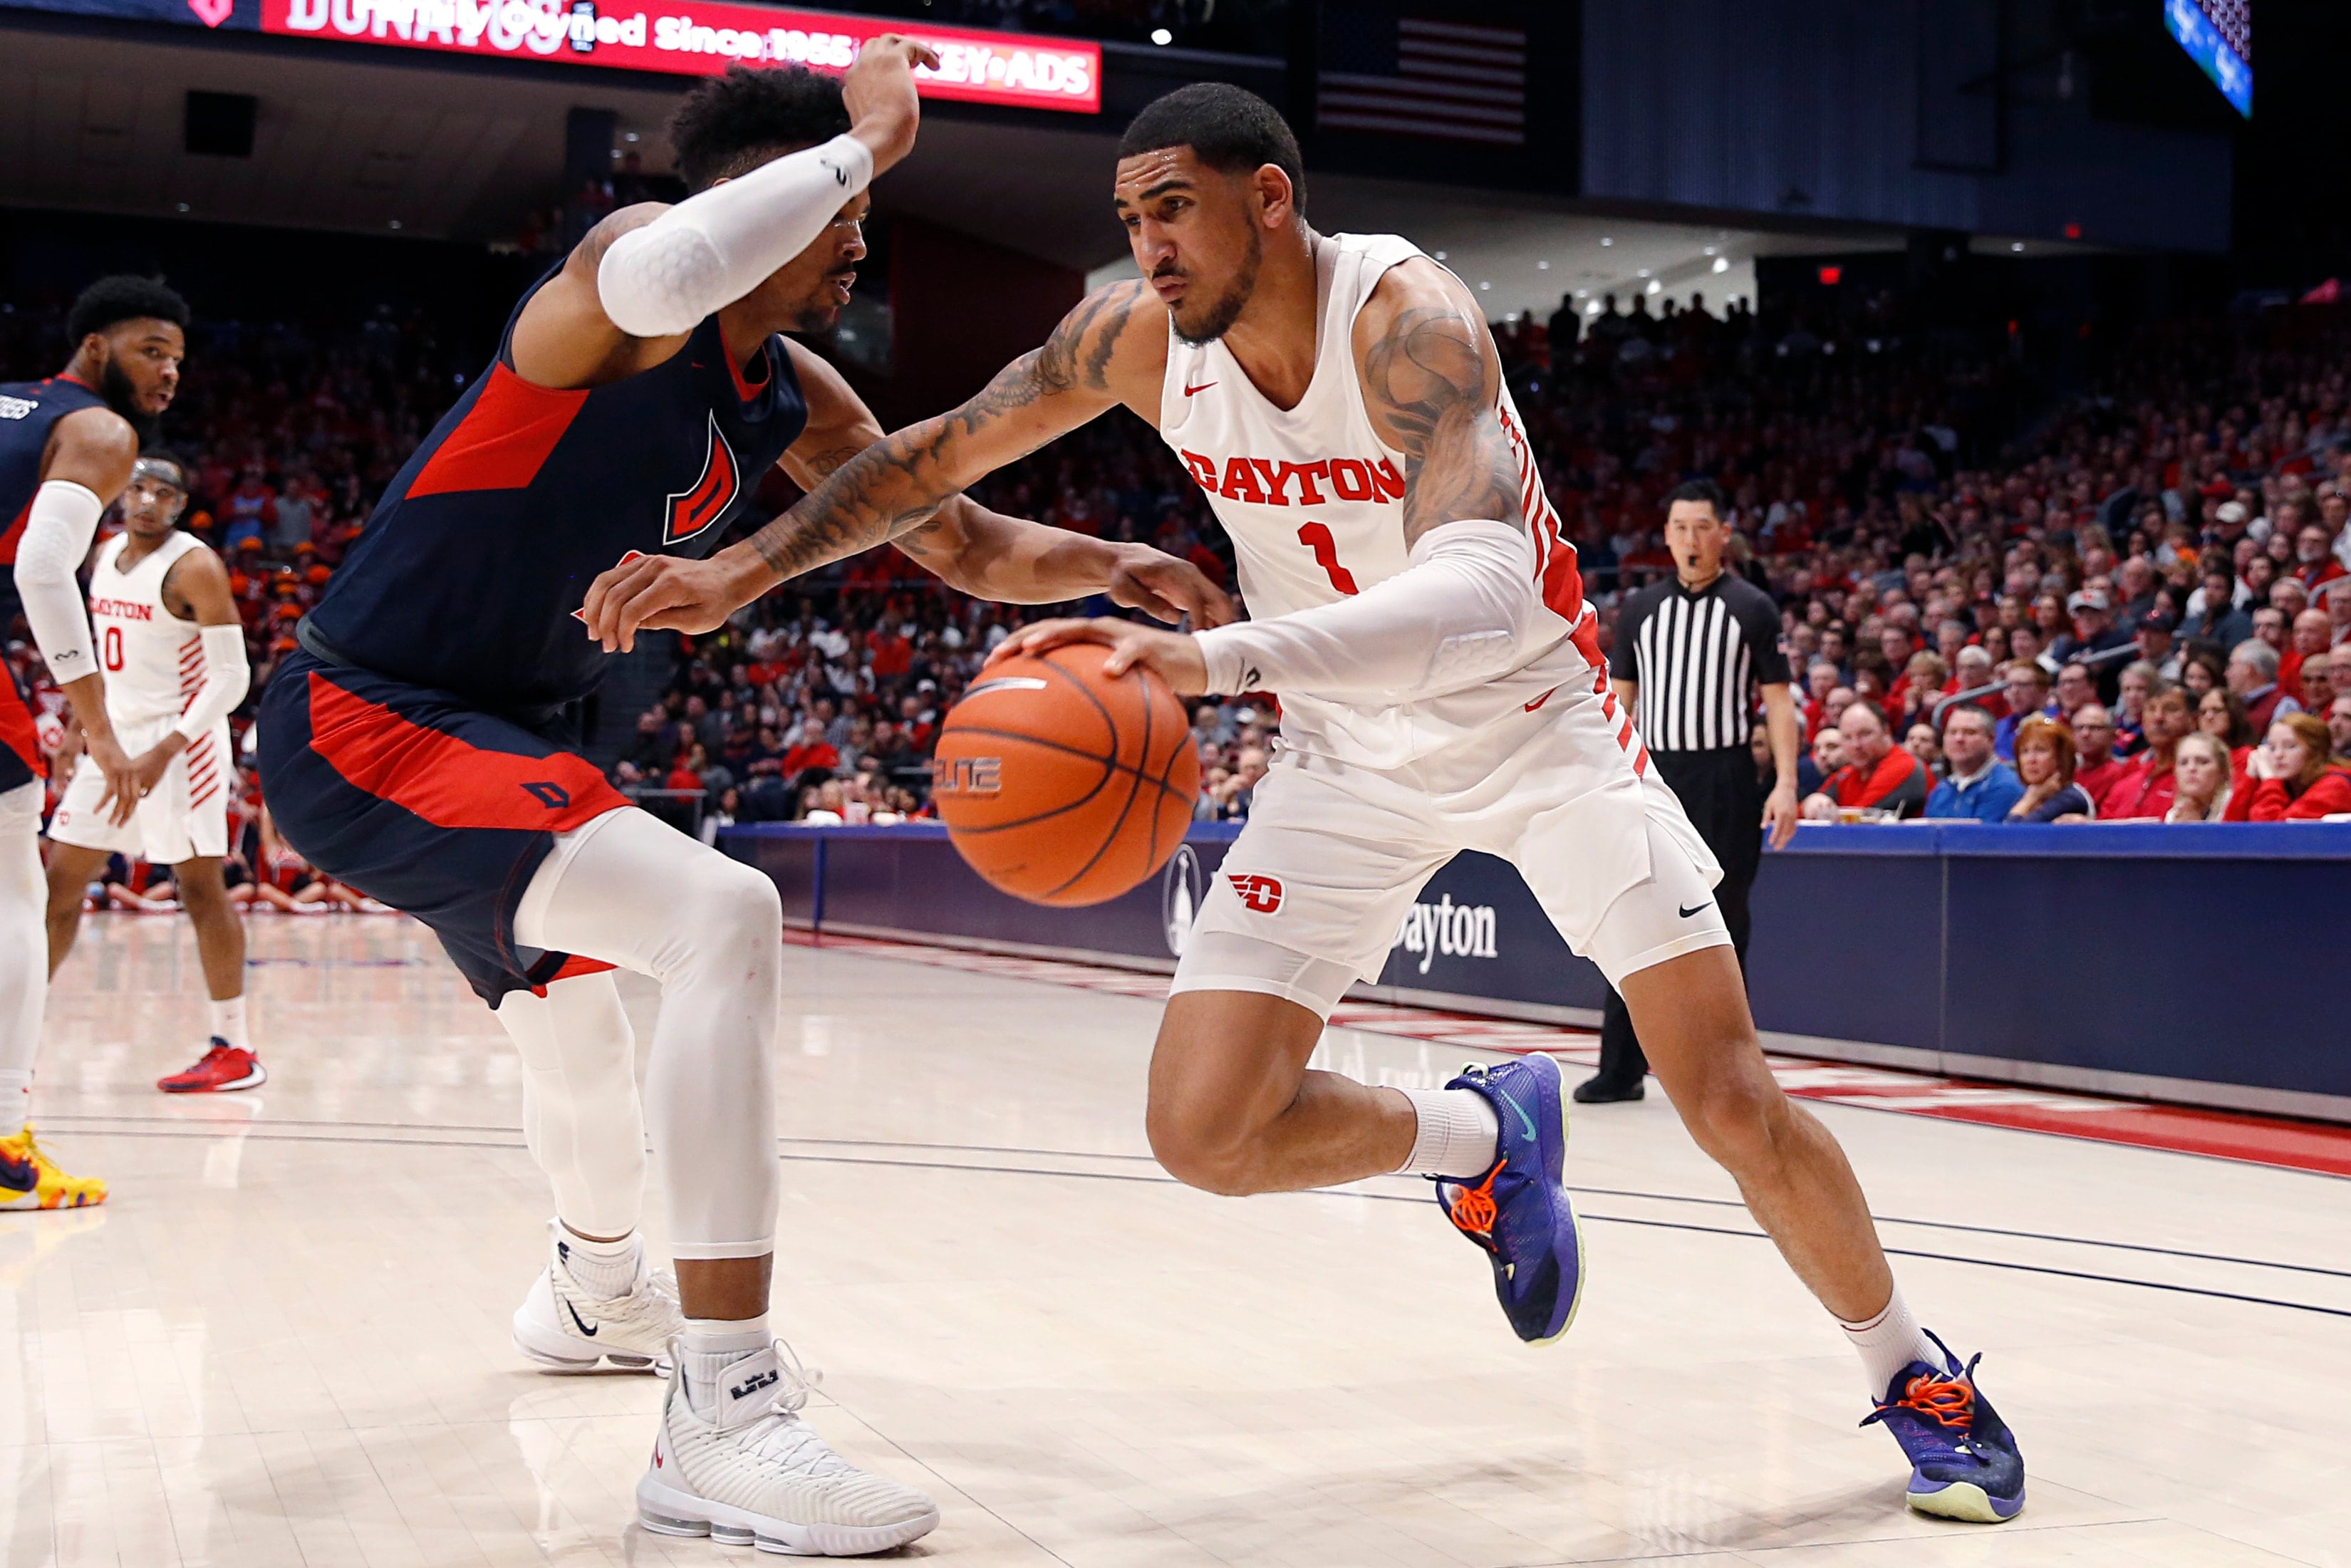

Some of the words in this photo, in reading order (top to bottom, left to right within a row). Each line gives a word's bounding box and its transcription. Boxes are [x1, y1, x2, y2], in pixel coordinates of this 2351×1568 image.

[654, 16, 762, 58] Since
[1297, 521, 1359, 596] 1
[106, 627, 123, 671] 0
[1391, 893, 1498, 975] ayton
